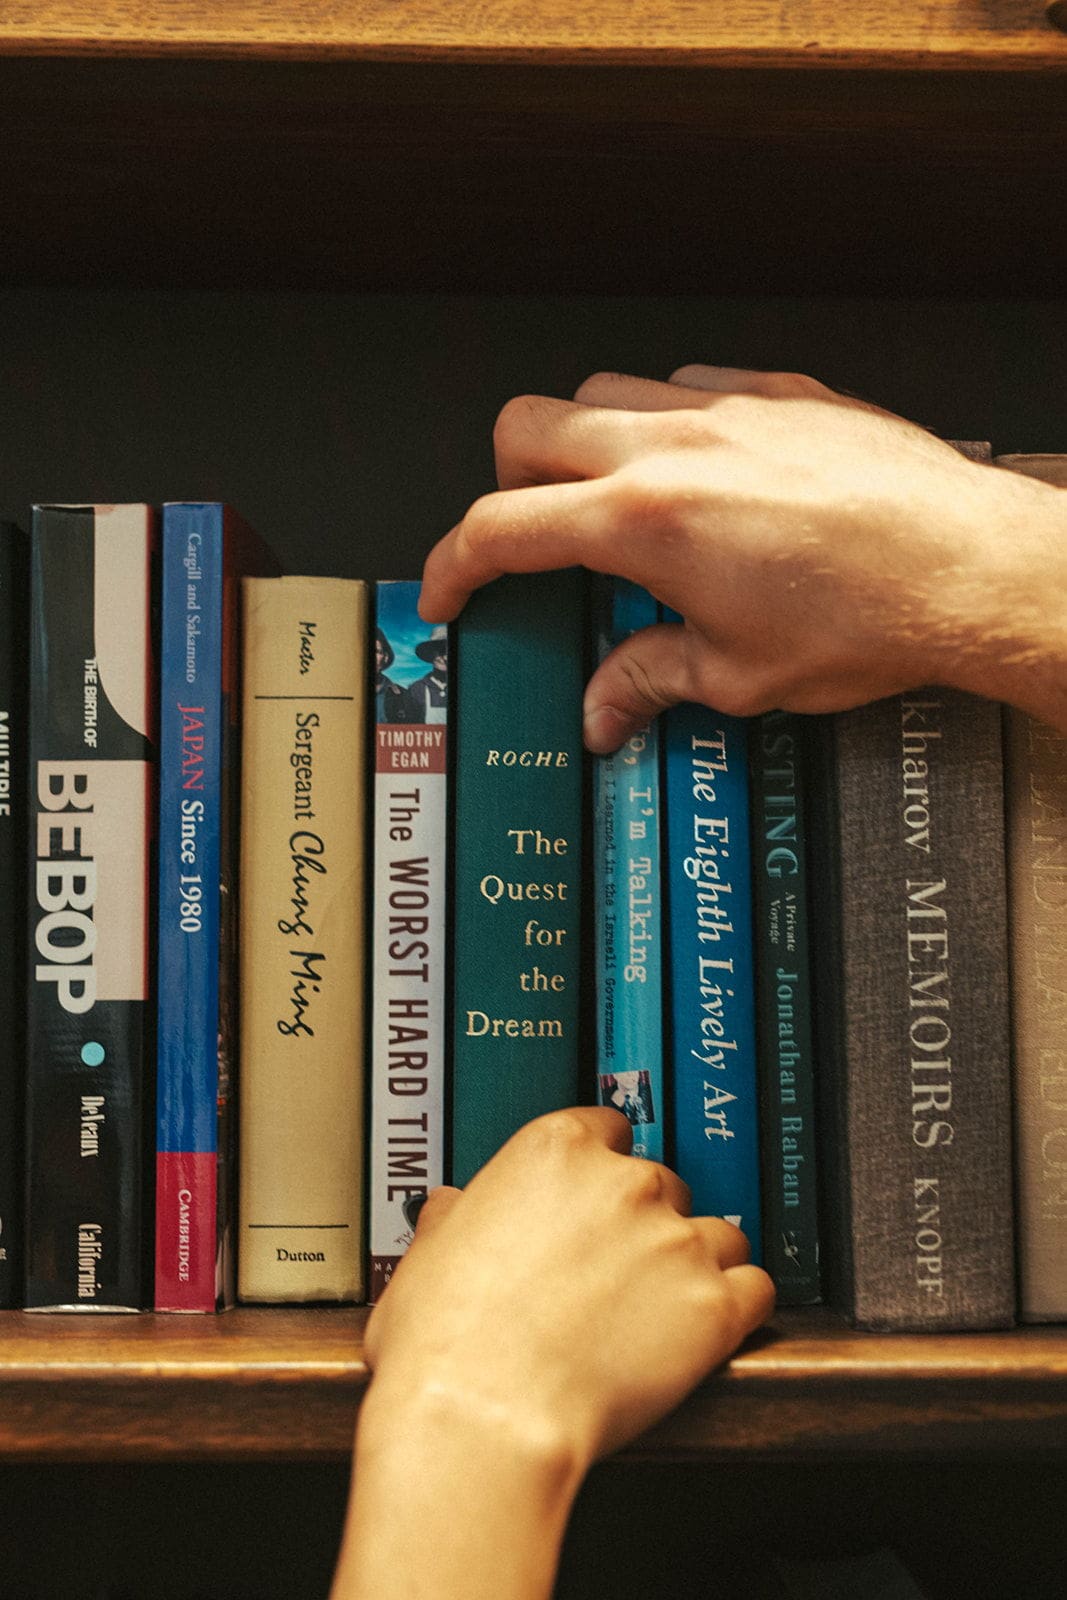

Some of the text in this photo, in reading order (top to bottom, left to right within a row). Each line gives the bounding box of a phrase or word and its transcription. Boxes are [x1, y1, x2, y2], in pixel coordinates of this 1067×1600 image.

[184, 532, 202, 684] Cargill and Sakamoto
[83, 658, 98, 748] THE BIRTH OF
[379, 730, 443, 748] TIMOTHY
[391, 750, 430, 768] EGAN
[486, 750, 569, 767] ROCHE
[762, 712, 799, 879] STING
[901, 700, 943, 854] kharov
[177, 702, 206, 934] JAPAN Since 1980
[507, 829, 568, 855] The
[605, 795, 617, 850] Learned
[628, 787, 655, 840] I'm
[35, 760, 98, 1014] BEBOP
[276, 712, 327, 1037] Sergeant Chung Ming
[479, 874, 568, 904] Quest
[604, 883, 616, 906] the
[605, 860, 616, 875] in
[525, 920, 567, 946] for
[604, 914, 616, 970] Israeli
[623, 857, 654, 984] Talking
[683, 730, 738, 1143] The Eighth Lively Art
[768, 898, 781, 945] Voyage
[784, 891, 797, 952] A Private
[386, 788, 430, 1202] The WORST HARD TIME
[519, 966, 566, 992] the
[466, 1011, 564, 1038] Dream
[603, 978, 616, 1058] Government
[905, 878, 954, 1149] MEMOIRS
[775, 967, 803, 1207] Jonathan Raban
[80, 1095, 105, 1158] DeVeaux
[77, 1223, 103, 1299] California
[177, 1189, 192, 1282] CAMBRIDGE
[276, 1249, 326, 1263] Dutton
[913, 1177, 943, 1298] KNOPF
